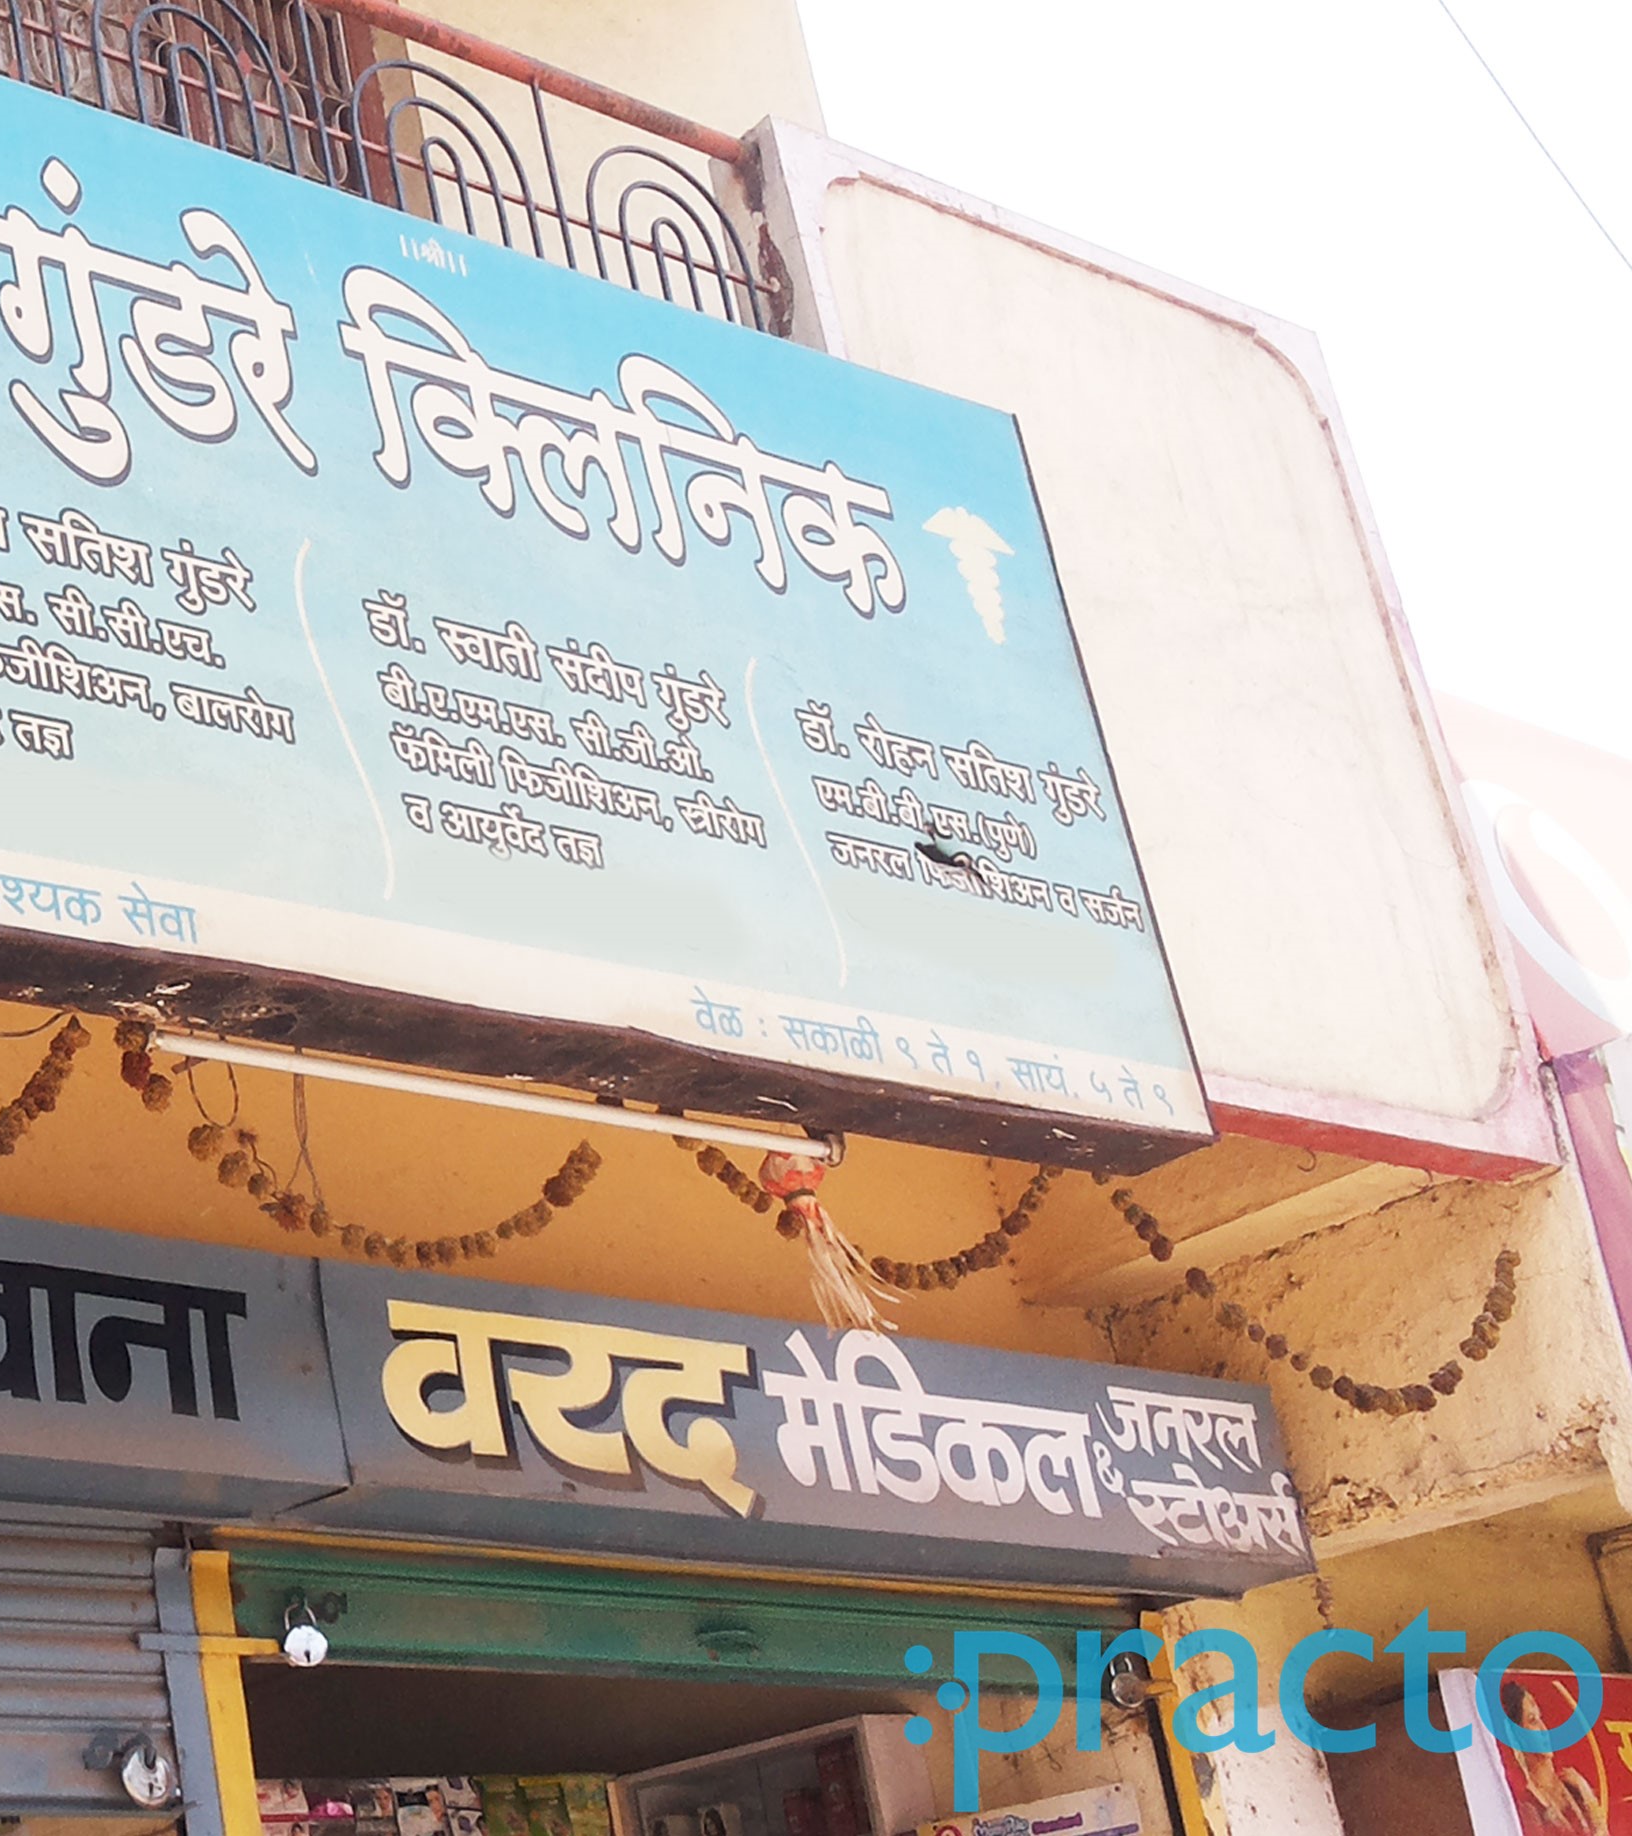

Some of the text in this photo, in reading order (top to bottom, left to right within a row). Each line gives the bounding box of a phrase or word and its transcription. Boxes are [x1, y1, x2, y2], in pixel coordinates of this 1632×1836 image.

[336, 264, 907, 620] क्लिनिक
[21, 508, 152, 586] सतिश
[162, 537, 256, 614] गुंडरे
[45, 584, 227, 670] सी.सी.एच.
[363, 589, 730, 731] डॉ. स्वाती संदीप गुंडरे
[11, 710, 73, 760] तज्ञ
[170, 681, 296, 744] बालरोग
[378, 662, 567, 748] बी.ए.एम.एस.
[794, 699, 1107, 825] डॉ. रोहन सतिश गुंडरे
[401, 793, 605, 869] व आयुर्वेद तज्ञ
[674, 791, 767, 848] स्त्रीरोग
[118, 880, 199, 944] सेवा
[825, 830, 914, 880] जनरल
[1053, 885, 1079, 918] व
[1079, 885, 1145, 932] सर्जन
[690, 985, 744, 1038] वेळ
[778, 1015, 885, 1064] सकाळी
[926, 1029, 953, 1077] ते
[1118, 1065, 1144, 1111] ते
[381, 1300, 1262, 1519] वरद मेडिकल & जनरल
